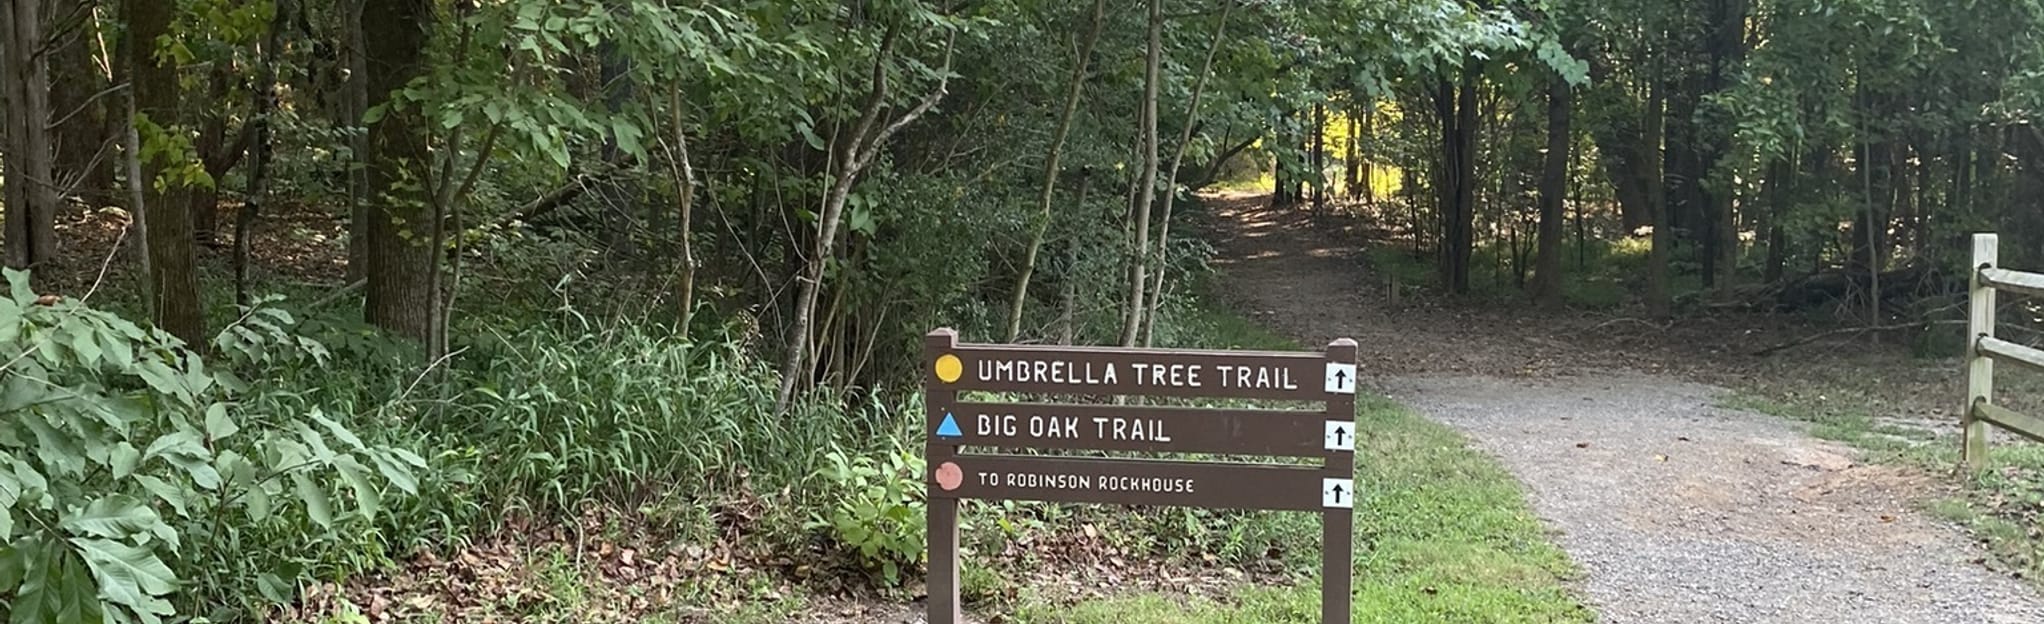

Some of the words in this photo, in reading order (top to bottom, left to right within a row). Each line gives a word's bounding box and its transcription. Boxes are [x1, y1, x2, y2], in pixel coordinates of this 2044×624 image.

[978, 359, 1118, 385] UMBRELLA
[1131, 363, 1202, 387] TREE
[1216, 365, 1298, 390] TRAIL
[977, 414, 1017, 437] BIG
[1029, 415, 1079, 439] OAK
[1092, 417, 1172, 442] TRAIL
[978, 472, 999, 487] TO
[1007, 472, 1091, 489] ROBINSON
[1098, 475, 1194, 493] ROCKHOUSE
